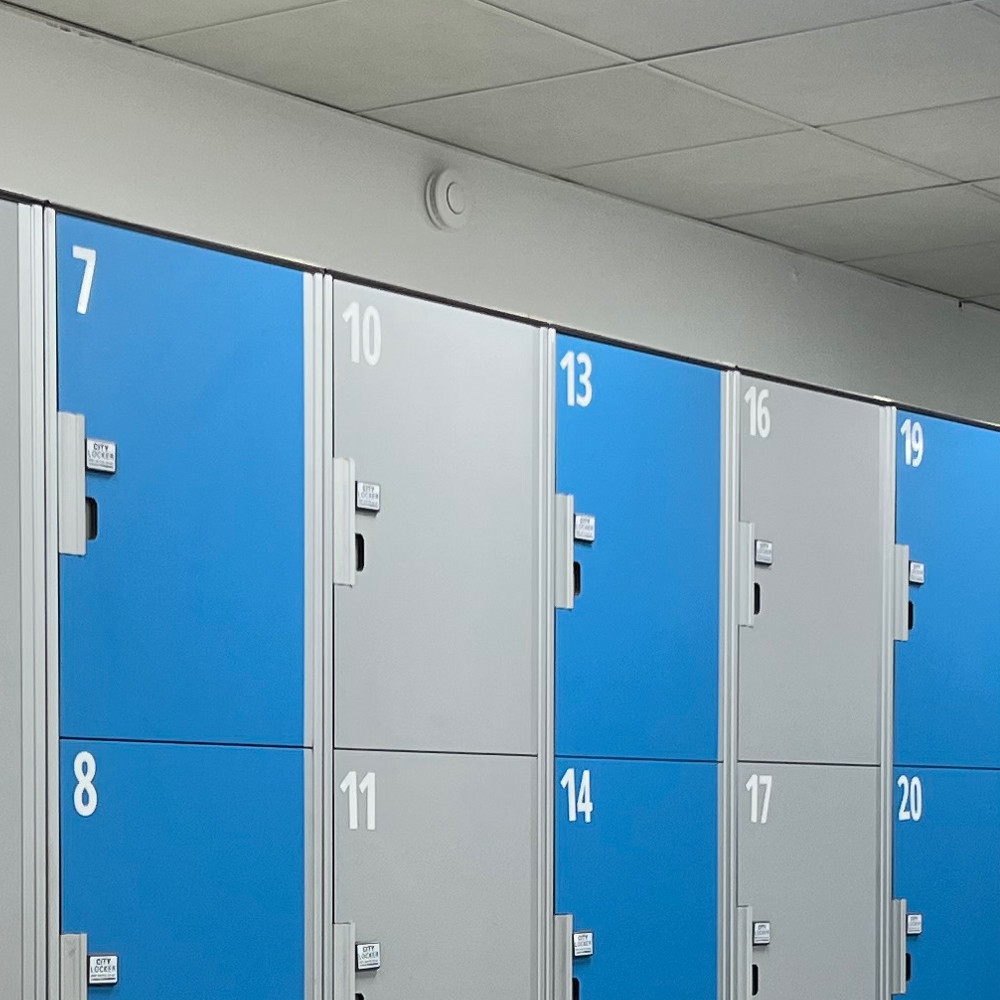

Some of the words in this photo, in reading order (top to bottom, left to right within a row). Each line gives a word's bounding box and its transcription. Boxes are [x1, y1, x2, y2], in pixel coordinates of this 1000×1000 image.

[72, 246, 97, 314] 7
[342, 301, 382, 366] 10
[559, 350, 593, 407] 13
[744, 385, 771, 438] 16
[93, 443, 108, 451] CITY
[900, 419, 924, 467] 19
[73, 750, 98, 816] 8
[339, 770, 376, 830] 11
[560, 768, 593, 823] 14
[745, 774, 773, 824] 17
[897, 774, 922, 821] 20
[90, 965, 115, 973] LOCKER
[96, 958, 111, 966] CITY
[362, 945, 374, 953] CITY
